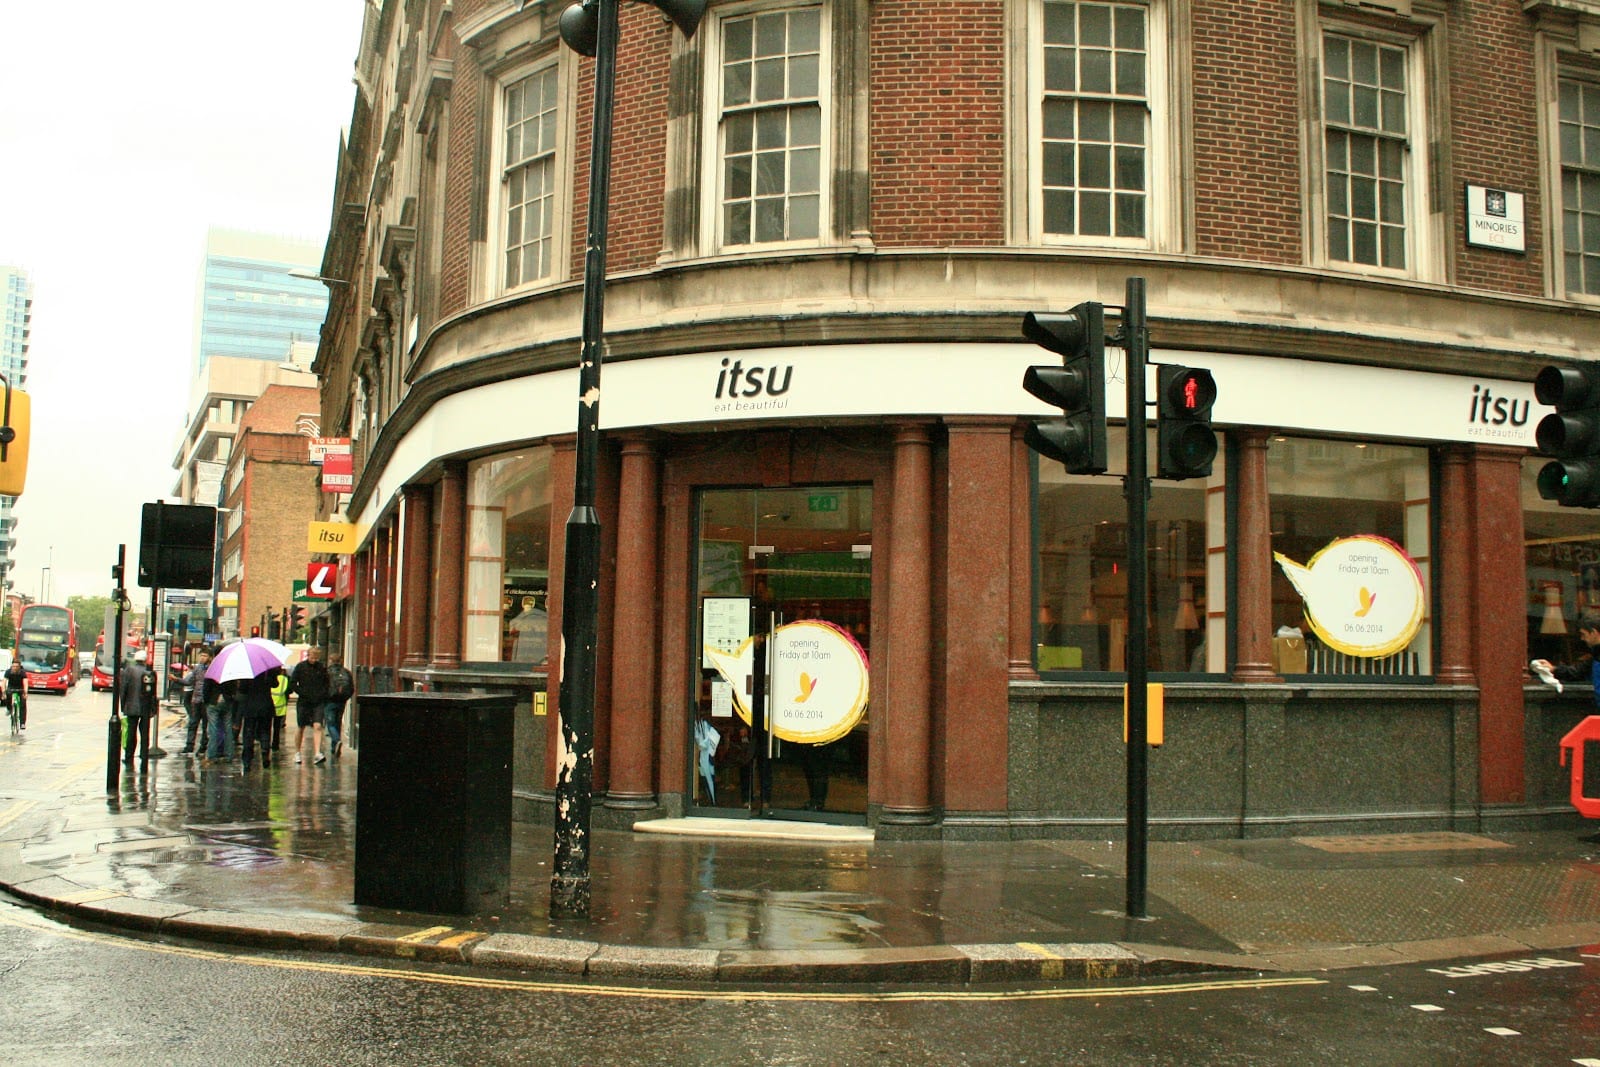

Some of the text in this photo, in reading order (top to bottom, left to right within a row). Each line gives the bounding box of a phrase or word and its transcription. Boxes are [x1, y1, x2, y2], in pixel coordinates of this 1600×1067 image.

[1475, 219, 1518, 235] MINORIES
[715, 357, 793, 399] itsu
[714, 398, 789, 413] eat beautiful
[1469, 384, 1530, 426] itsu
[1468, 427, 1527, 439] eat beautiful
[325, 475, 337, 483] LET
[319, 529, 344, 542] itsu
[1348, 554, 1378, 565] opening
[1339, 563, 1390, 575] Friday at 10am
[1344, 623, 1383, 633] 06.06.2014
[789, 640, 819, 650] opening
[779, 650, 831, 660] Friday at 10am
[783, 709, 824, 719] 06.06.2014
[1426, 957, 1584, 978] RIGHT
